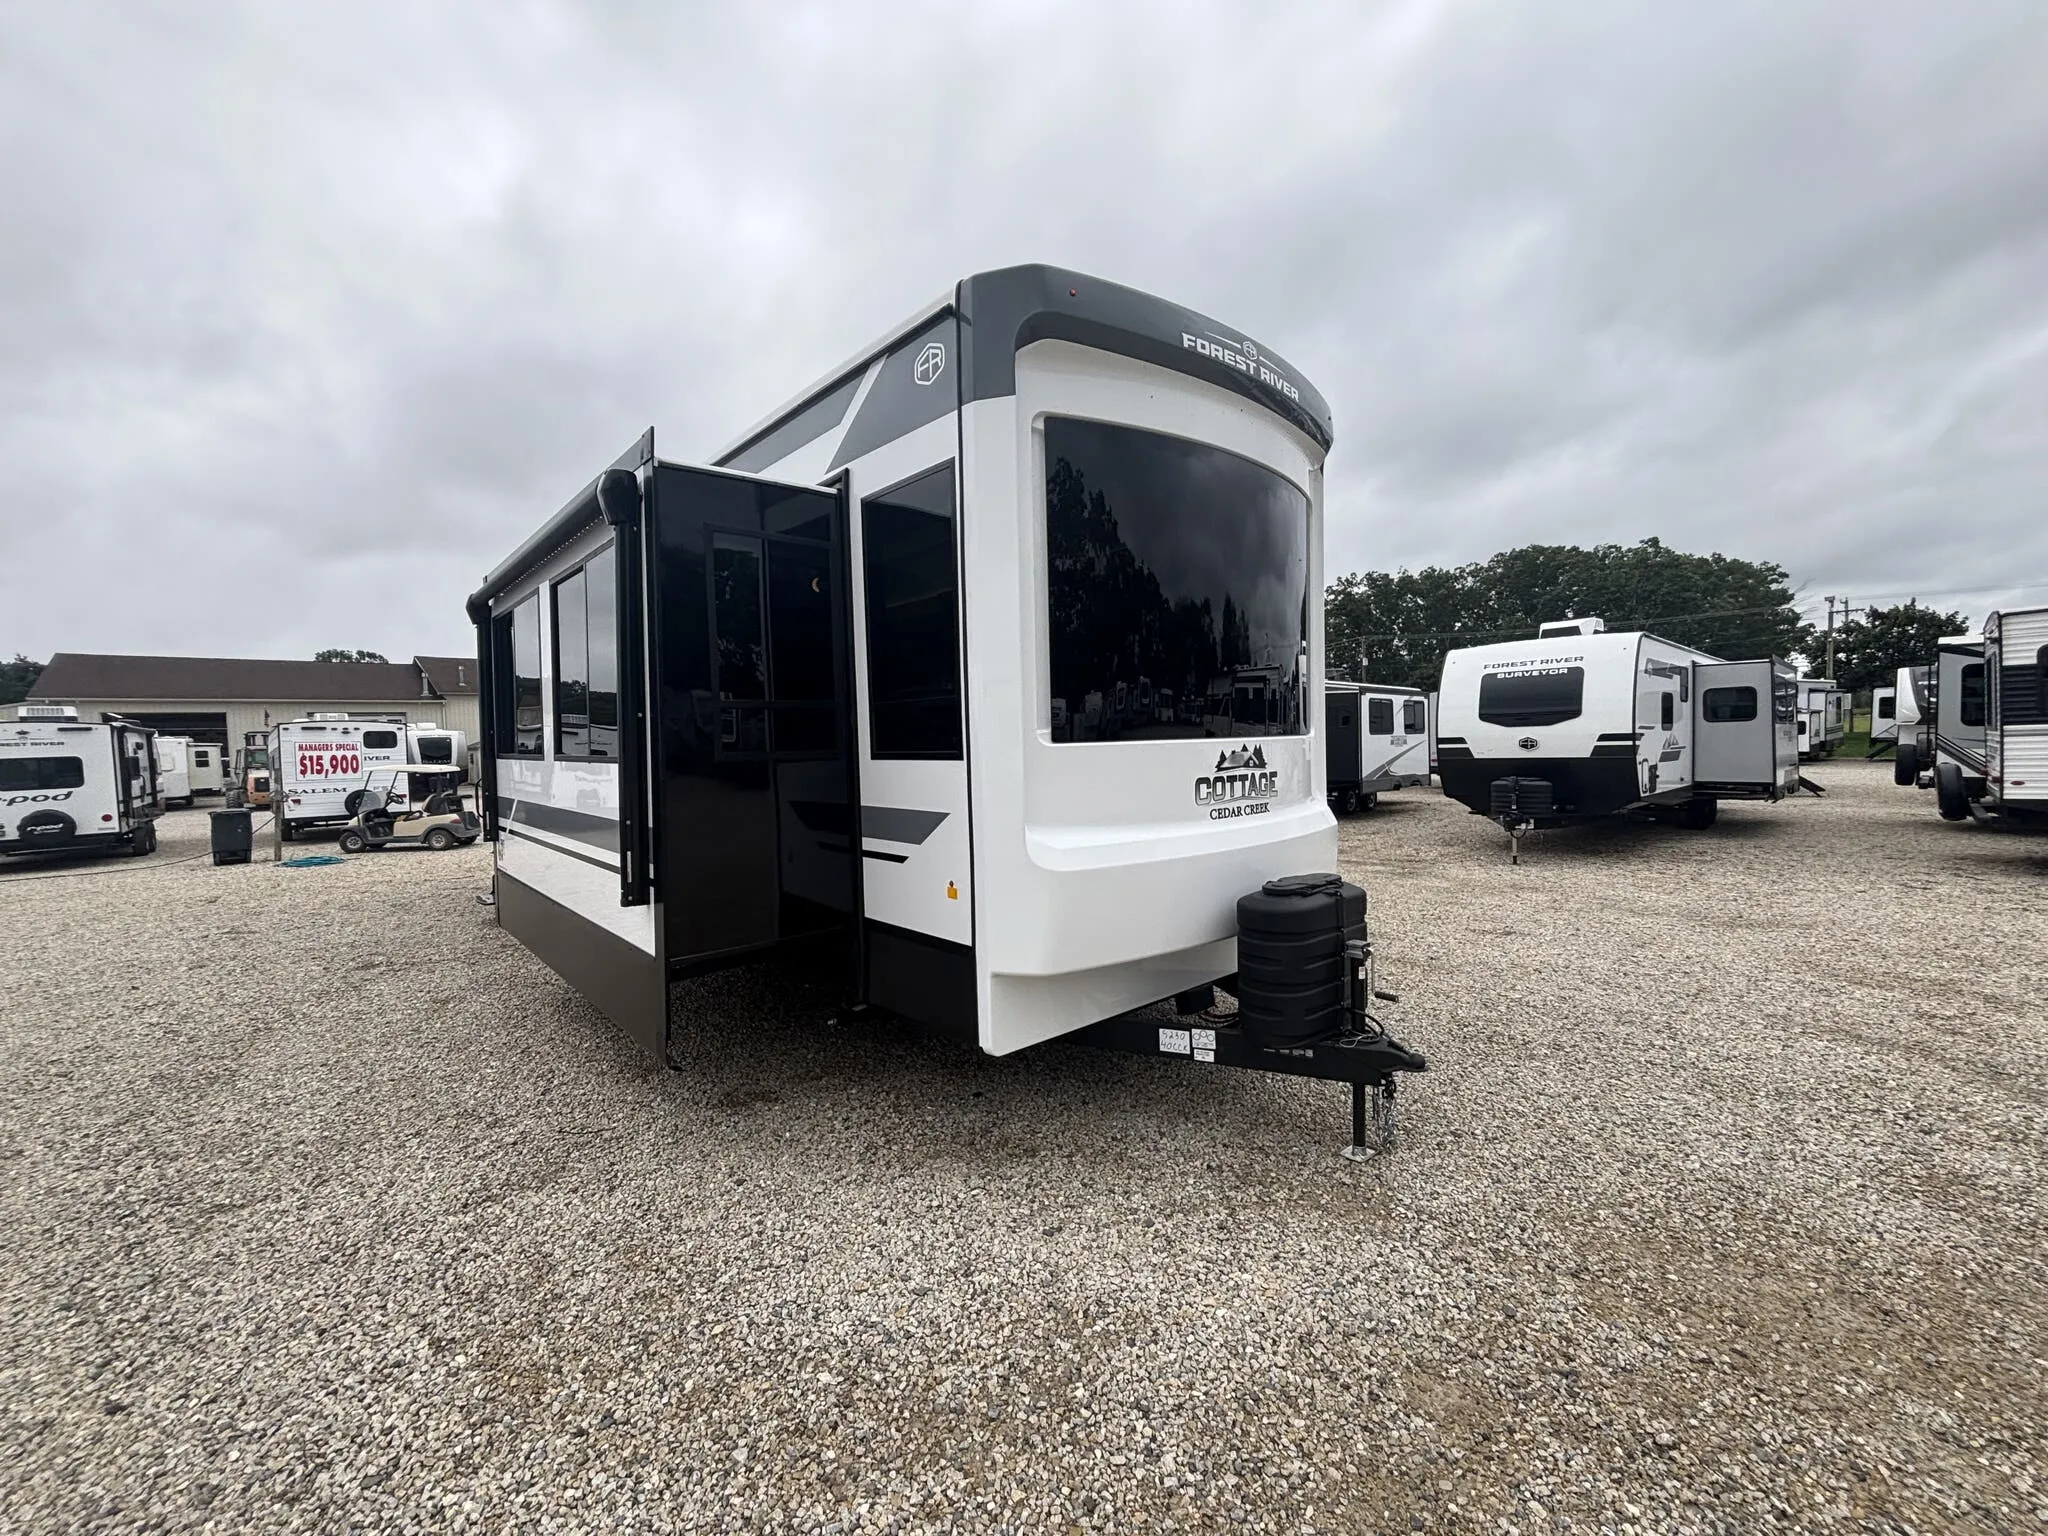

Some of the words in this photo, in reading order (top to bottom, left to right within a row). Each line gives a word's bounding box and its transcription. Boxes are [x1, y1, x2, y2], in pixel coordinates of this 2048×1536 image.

[1181, 332, 1256, 375] FOREST
[1260, 365, 1299, 402] RIVER
[1483, 660, 1538, 670] FOREST
[1540, 656, 1584, 665] RIVER
[1497, 668, 1569, 679] SURVEYOR
[298, 743, 333, 752] MANAGERS
[335, 743, 359, 751] SPECIAL
[299, 753, 360, 778] $15,900
[287, 787, 347, 795] SALEM
[1195, 771, 1279, 806] COTTAGE
[0, 790, 74, 807] -pod
[1209, 805, 1243, 820] CEDAR
[1244, 802, 1270, 815] CREEK
